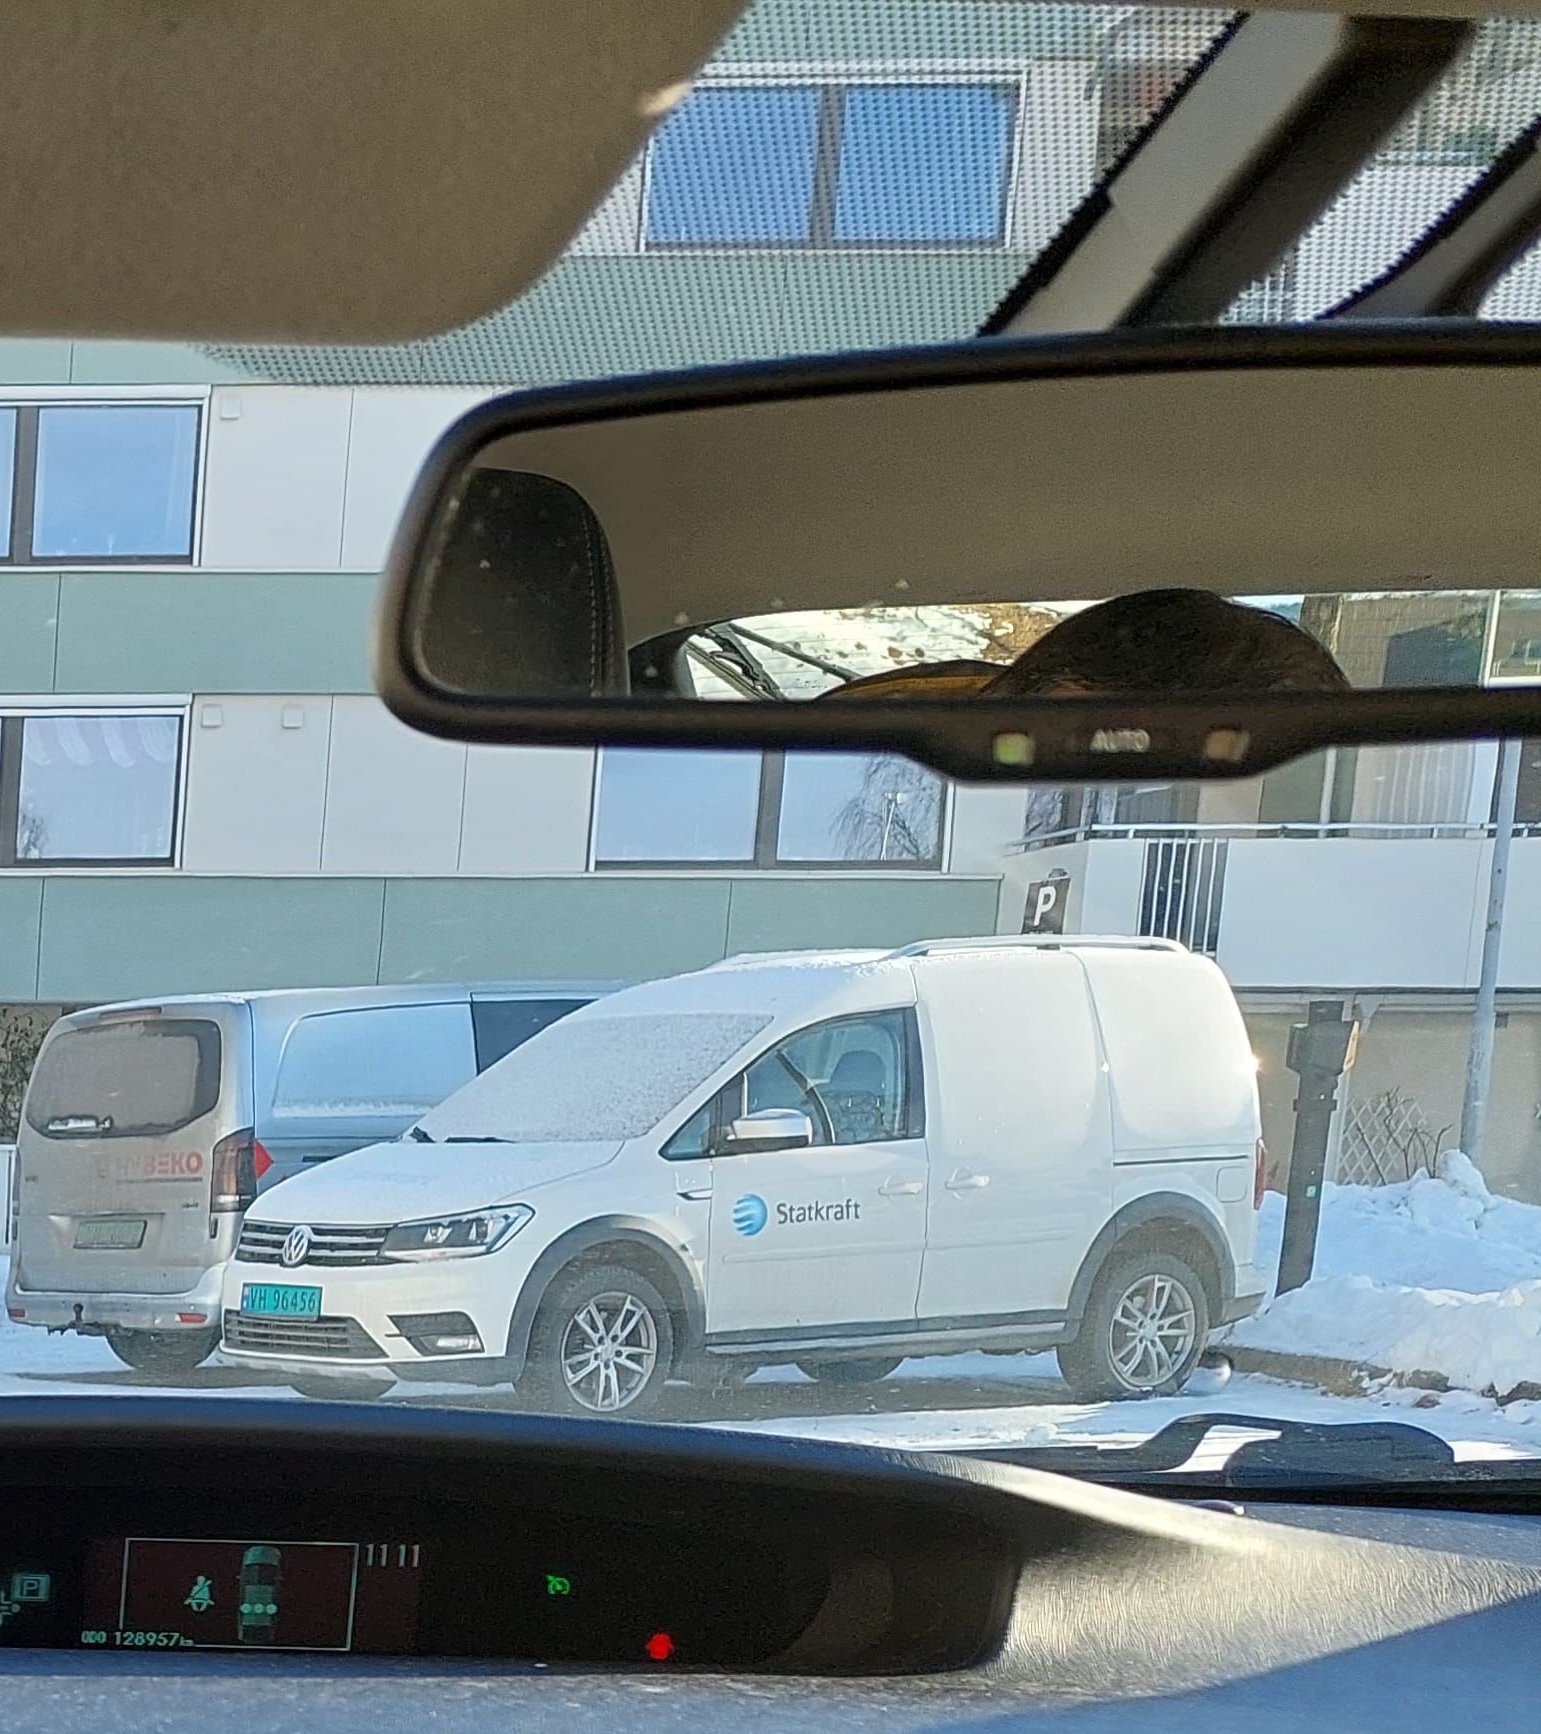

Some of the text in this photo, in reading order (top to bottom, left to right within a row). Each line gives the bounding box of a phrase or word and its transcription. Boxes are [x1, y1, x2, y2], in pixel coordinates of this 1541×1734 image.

[1089, 729, 1150, 753] AUTO
[1033, 886, 1056, 926] P
[777, 1199, 860, 1224] Statkraft
[250, 1286, 316, 1312] VH 96456
[23, 1579, 38, 1596] P
[113, 1631, 179, 1647] 128957
